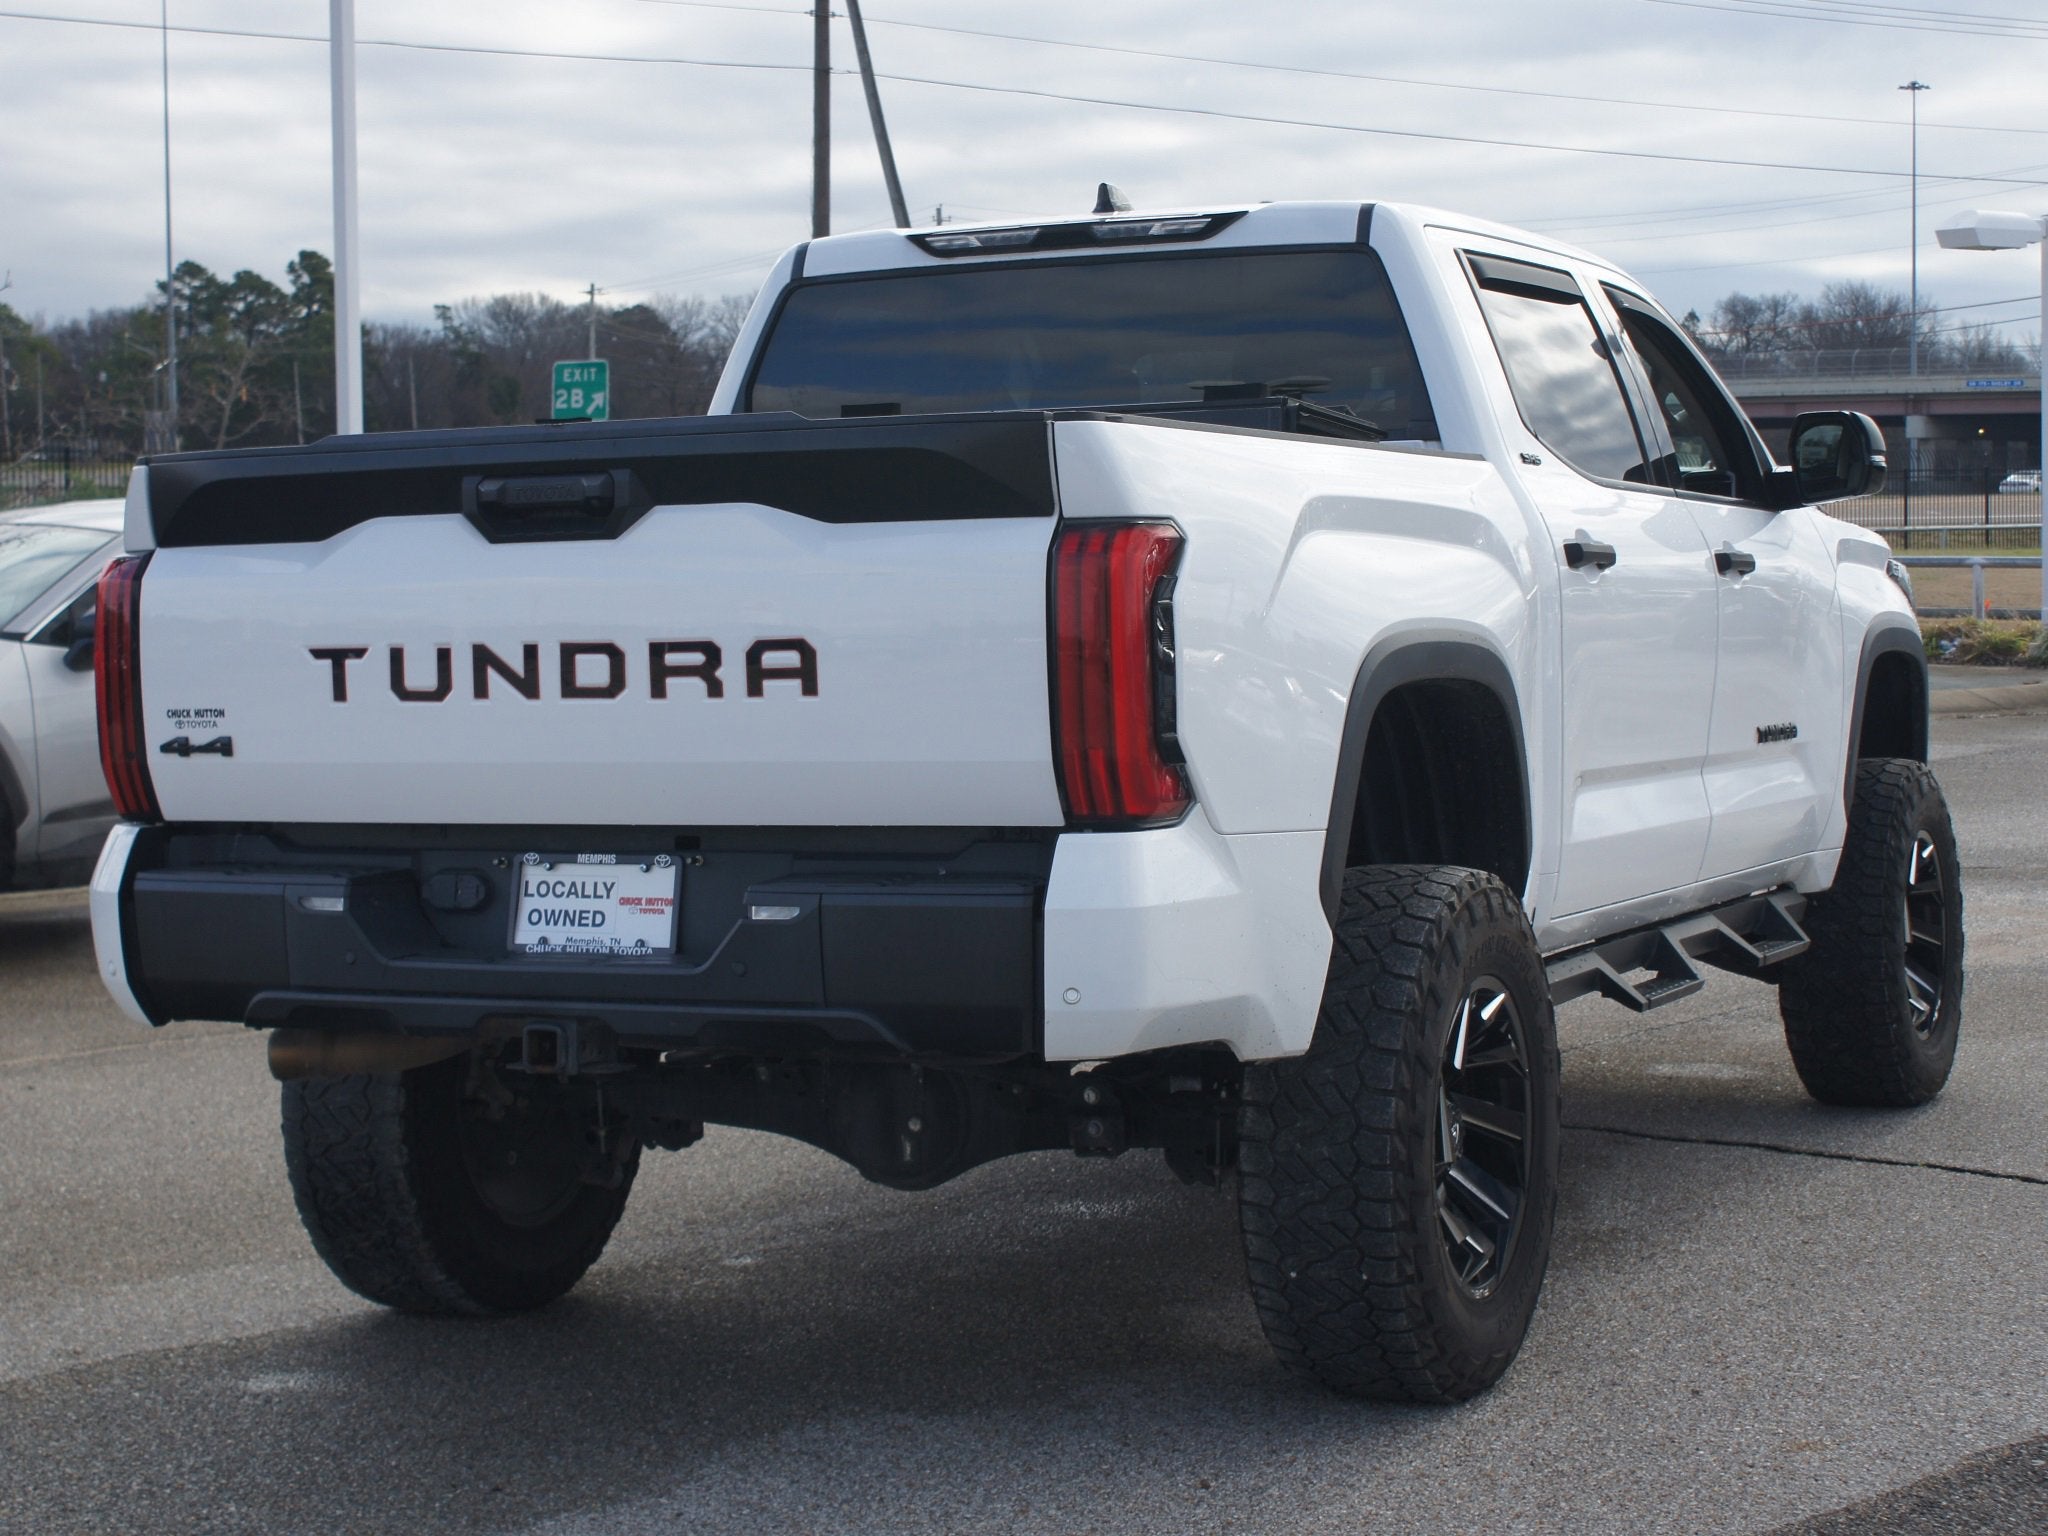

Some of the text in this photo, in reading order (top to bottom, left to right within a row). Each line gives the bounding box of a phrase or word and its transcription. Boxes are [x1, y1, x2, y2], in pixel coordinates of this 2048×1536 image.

[563, 368, 597, 382] EXIT
[555, 388, 584, 409] 2B
[514, 485, 576, 500] TOYOTA
[307, 637, 819, 703] TUNDRA
[166, 708, 225, 719] CHUCK HUTTON
[187, 720, 218, 729] TOYOTA
[577, 854, 616, 864] MEMPHIS
[523, 880, 616, 899] LOCALLY
[619, 897, 643, 906] CHUCK
[527, 908, 606, 928] OWNED
[565, 936, 621, 946] Memphis, TN
